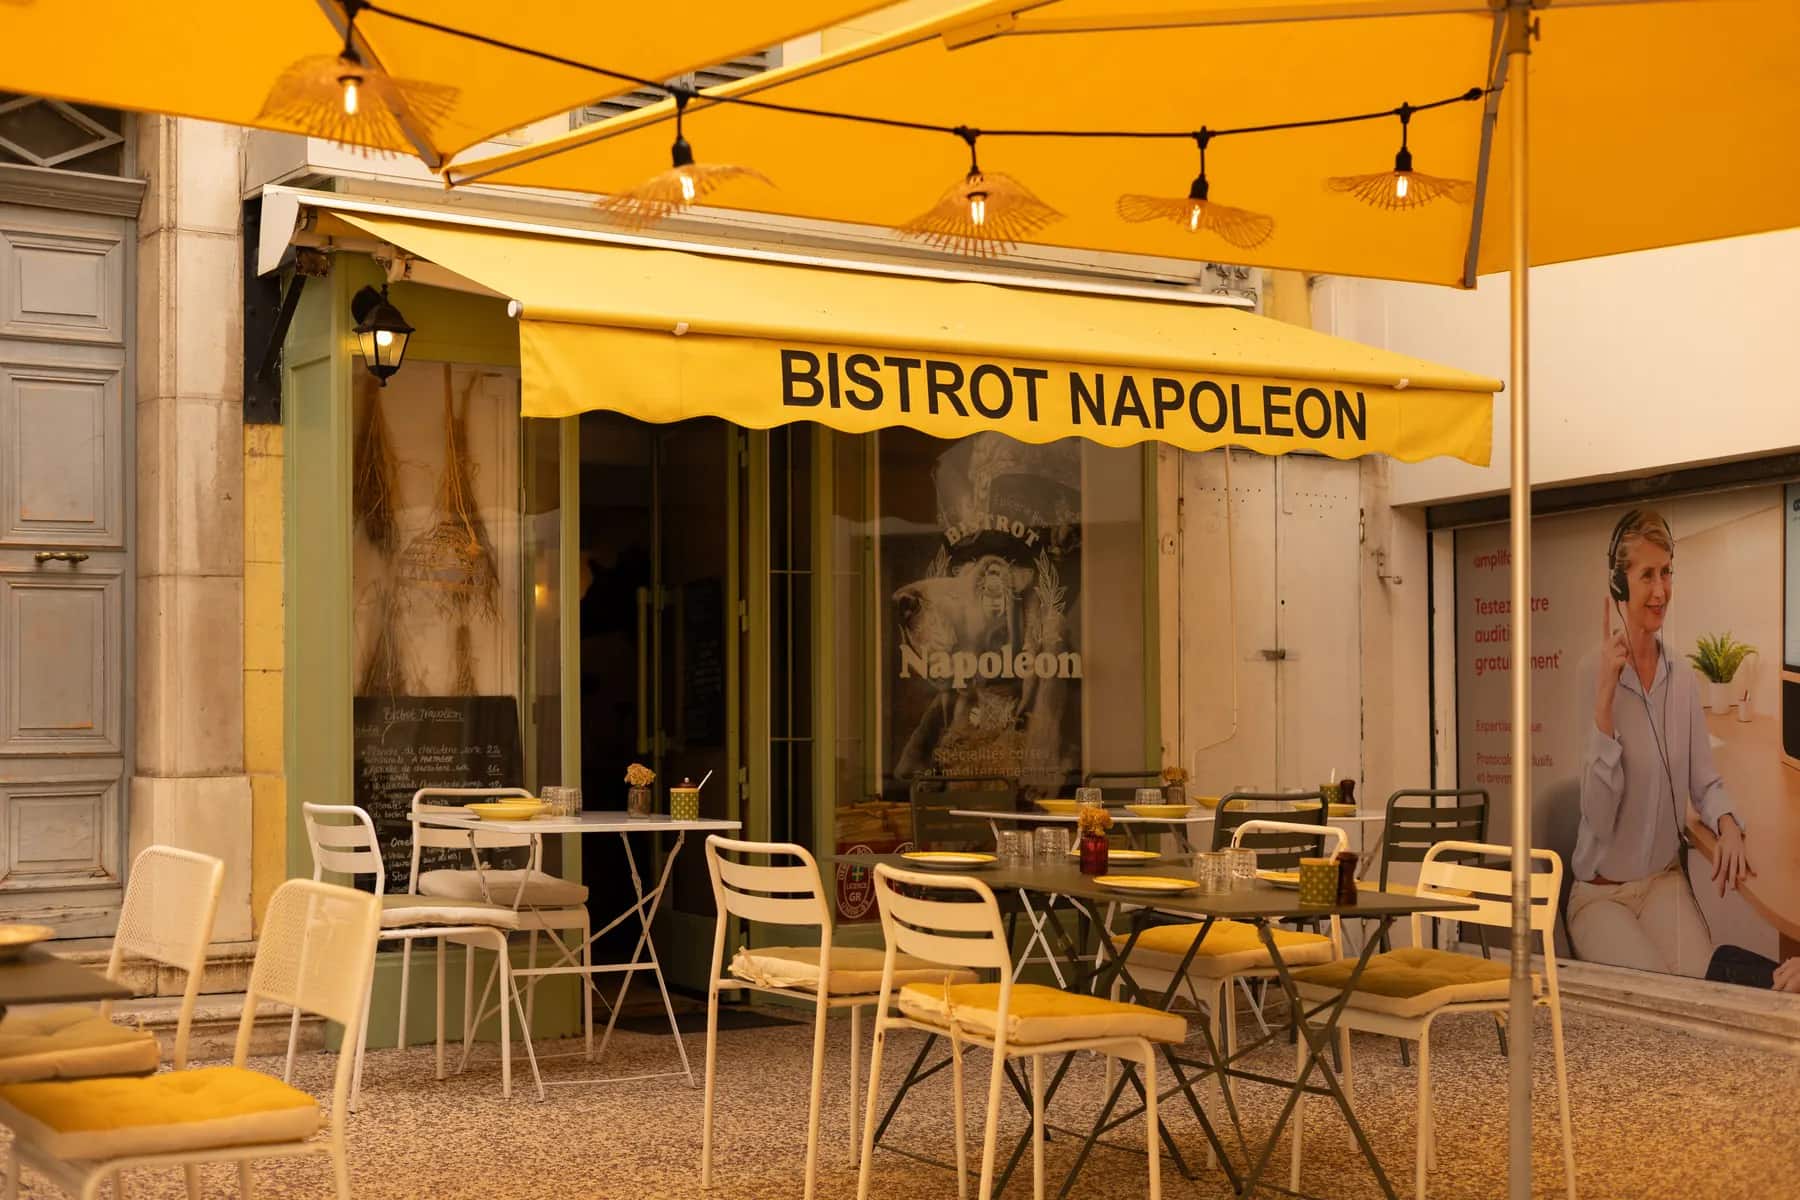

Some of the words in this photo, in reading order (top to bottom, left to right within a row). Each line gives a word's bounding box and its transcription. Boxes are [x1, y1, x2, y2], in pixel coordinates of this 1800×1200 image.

[780, 349, 1048, 422] BISTROT
[1070, 371, 1367, 441] NAPOLEON
[944, 512, 1041, 547] BISTROT
[1473, 549, 1512, 571] amplifo
[1475, 598, 1512, 616] Testez
[1475, 624, 1512, 643] auditi
